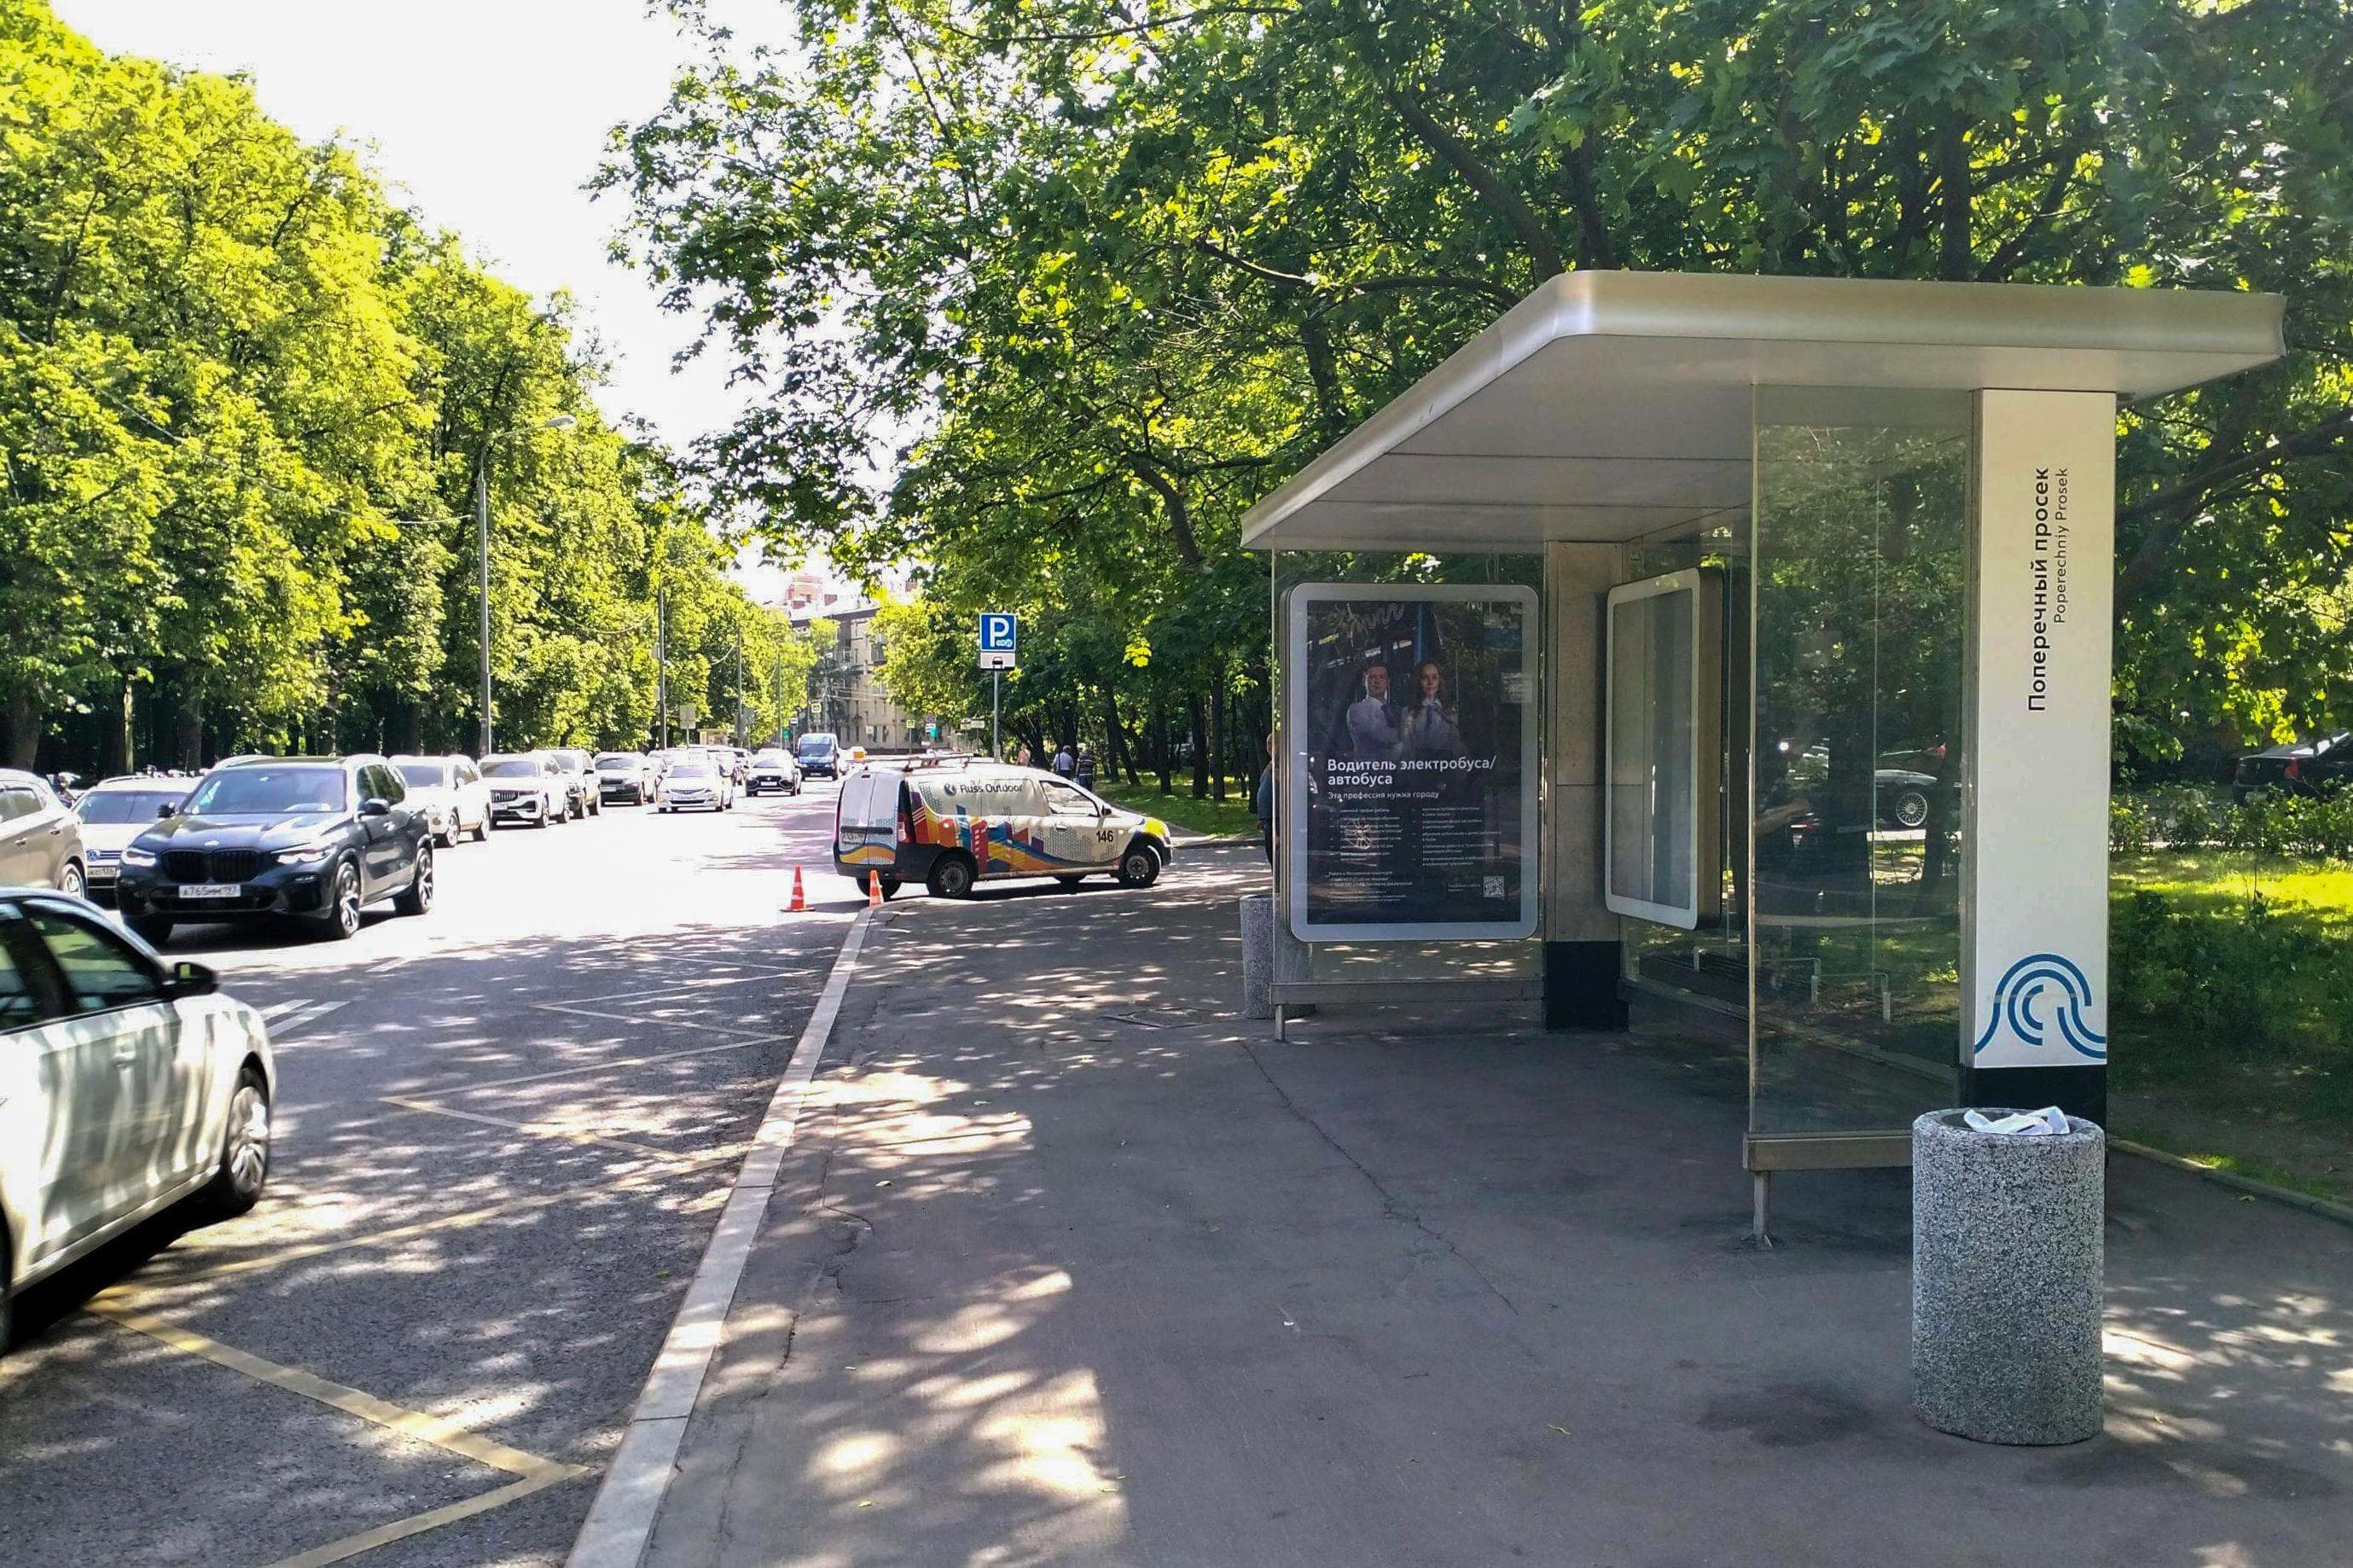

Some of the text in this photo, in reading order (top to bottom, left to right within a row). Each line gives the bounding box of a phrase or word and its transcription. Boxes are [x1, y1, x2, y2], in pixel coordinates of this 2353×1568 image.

[2054, 467, 2070, 624] Poperechniy Prosek
[2028, 467, 2052, 711] Поперечный просек
[990, 618, 1009, 648] P
[1327, 756, 1496, 773] Водитель электробуса/
[1328, 773, 1393, 787] автобуса
[960, 783, 1023, 793] Russ Outdoor
[1343, 792, 1386, 800] профессия
[1095, 830, 1114, 843] 146
